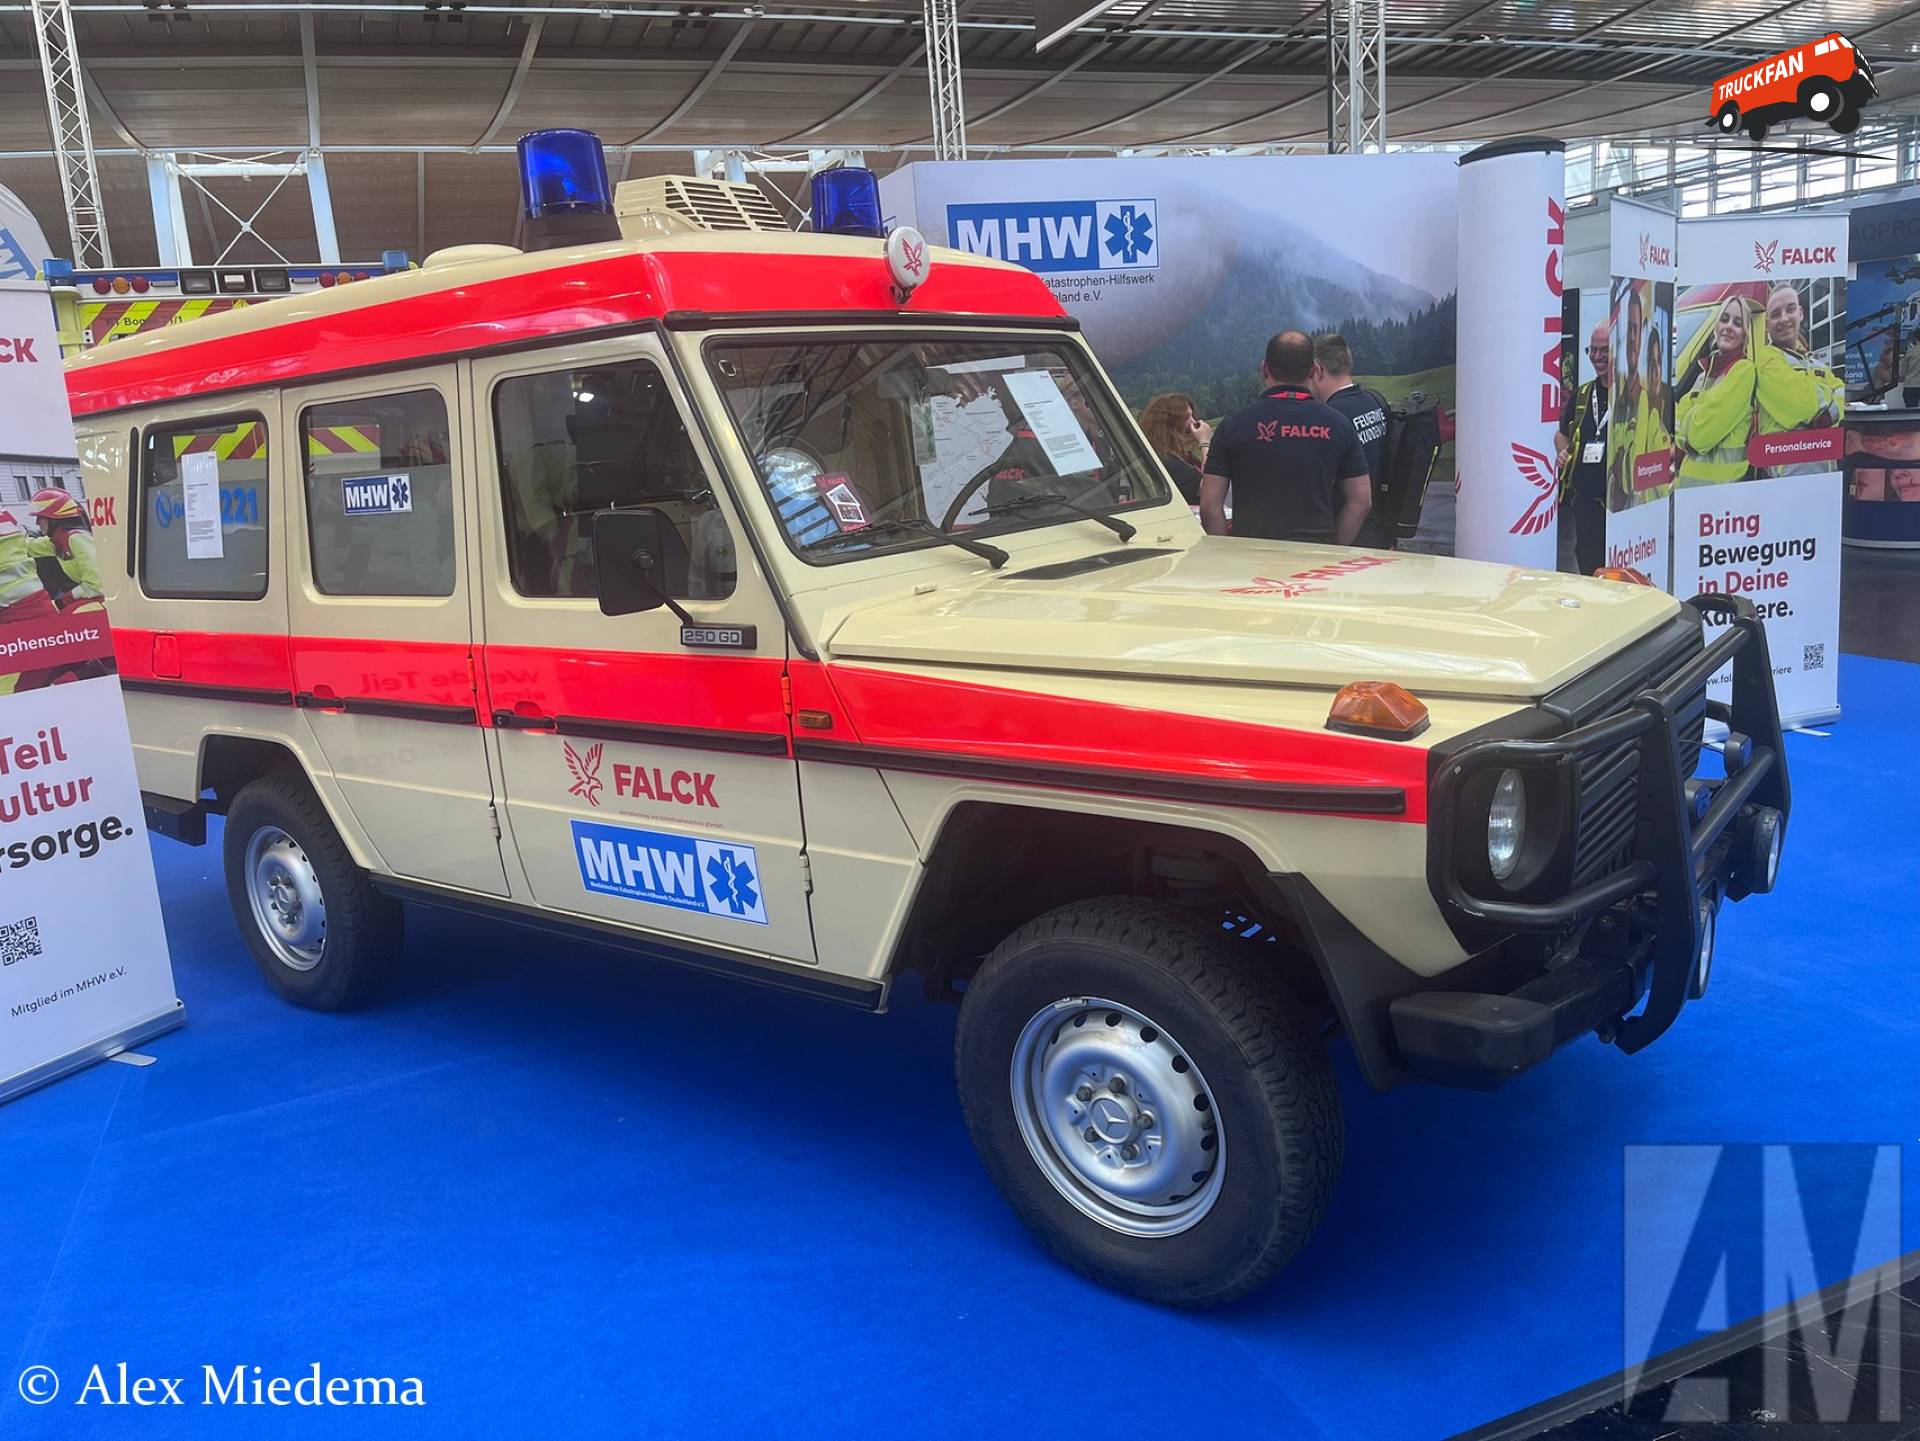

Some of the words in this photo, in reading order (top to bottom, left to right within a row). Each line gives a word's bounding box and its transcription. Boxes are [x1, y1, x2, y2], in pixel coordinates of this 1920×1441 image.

[956, 215, 1093, 260] MHW
[1650, 245, 1670, 266] FALCK
[1782, 246, 1836, 265] FALCK
[1083, 290, 1103, 302] e.V.
[1281, 425, 1330, 440] FALCK
[1765, 439, 1832, 454] Personalservice
[345, 484, 388, 508] MHW
[1698, 510, 1760, 537] Bring
[1609, 539, 1633, 568] Mach
[1634, 536, 1656, 562] einen
[1699, 537, 1816, 567] Bewegung
[1290, 556, 1399, 581] FALCK
[1698, 575, 1718, 594] in
[1725, 568, 1789, 594] Deine
[0, 628, 99, 657] ophenschutz
[685, 630, 716, 642] 250
[719, 631, 740, 643] GD
[0, 726, 67, 775] Teil
[0, 776, 93, 823] ultur
[613, 764, 720, 808] FALCK
[580, 837, 695, 897] MHW
[11, 991, 58, 1017] Mitglied
[60, 986, 74, 998] im
[76, 973, 107, 992] MHW
[109, 966, 127, 980] e.V.
